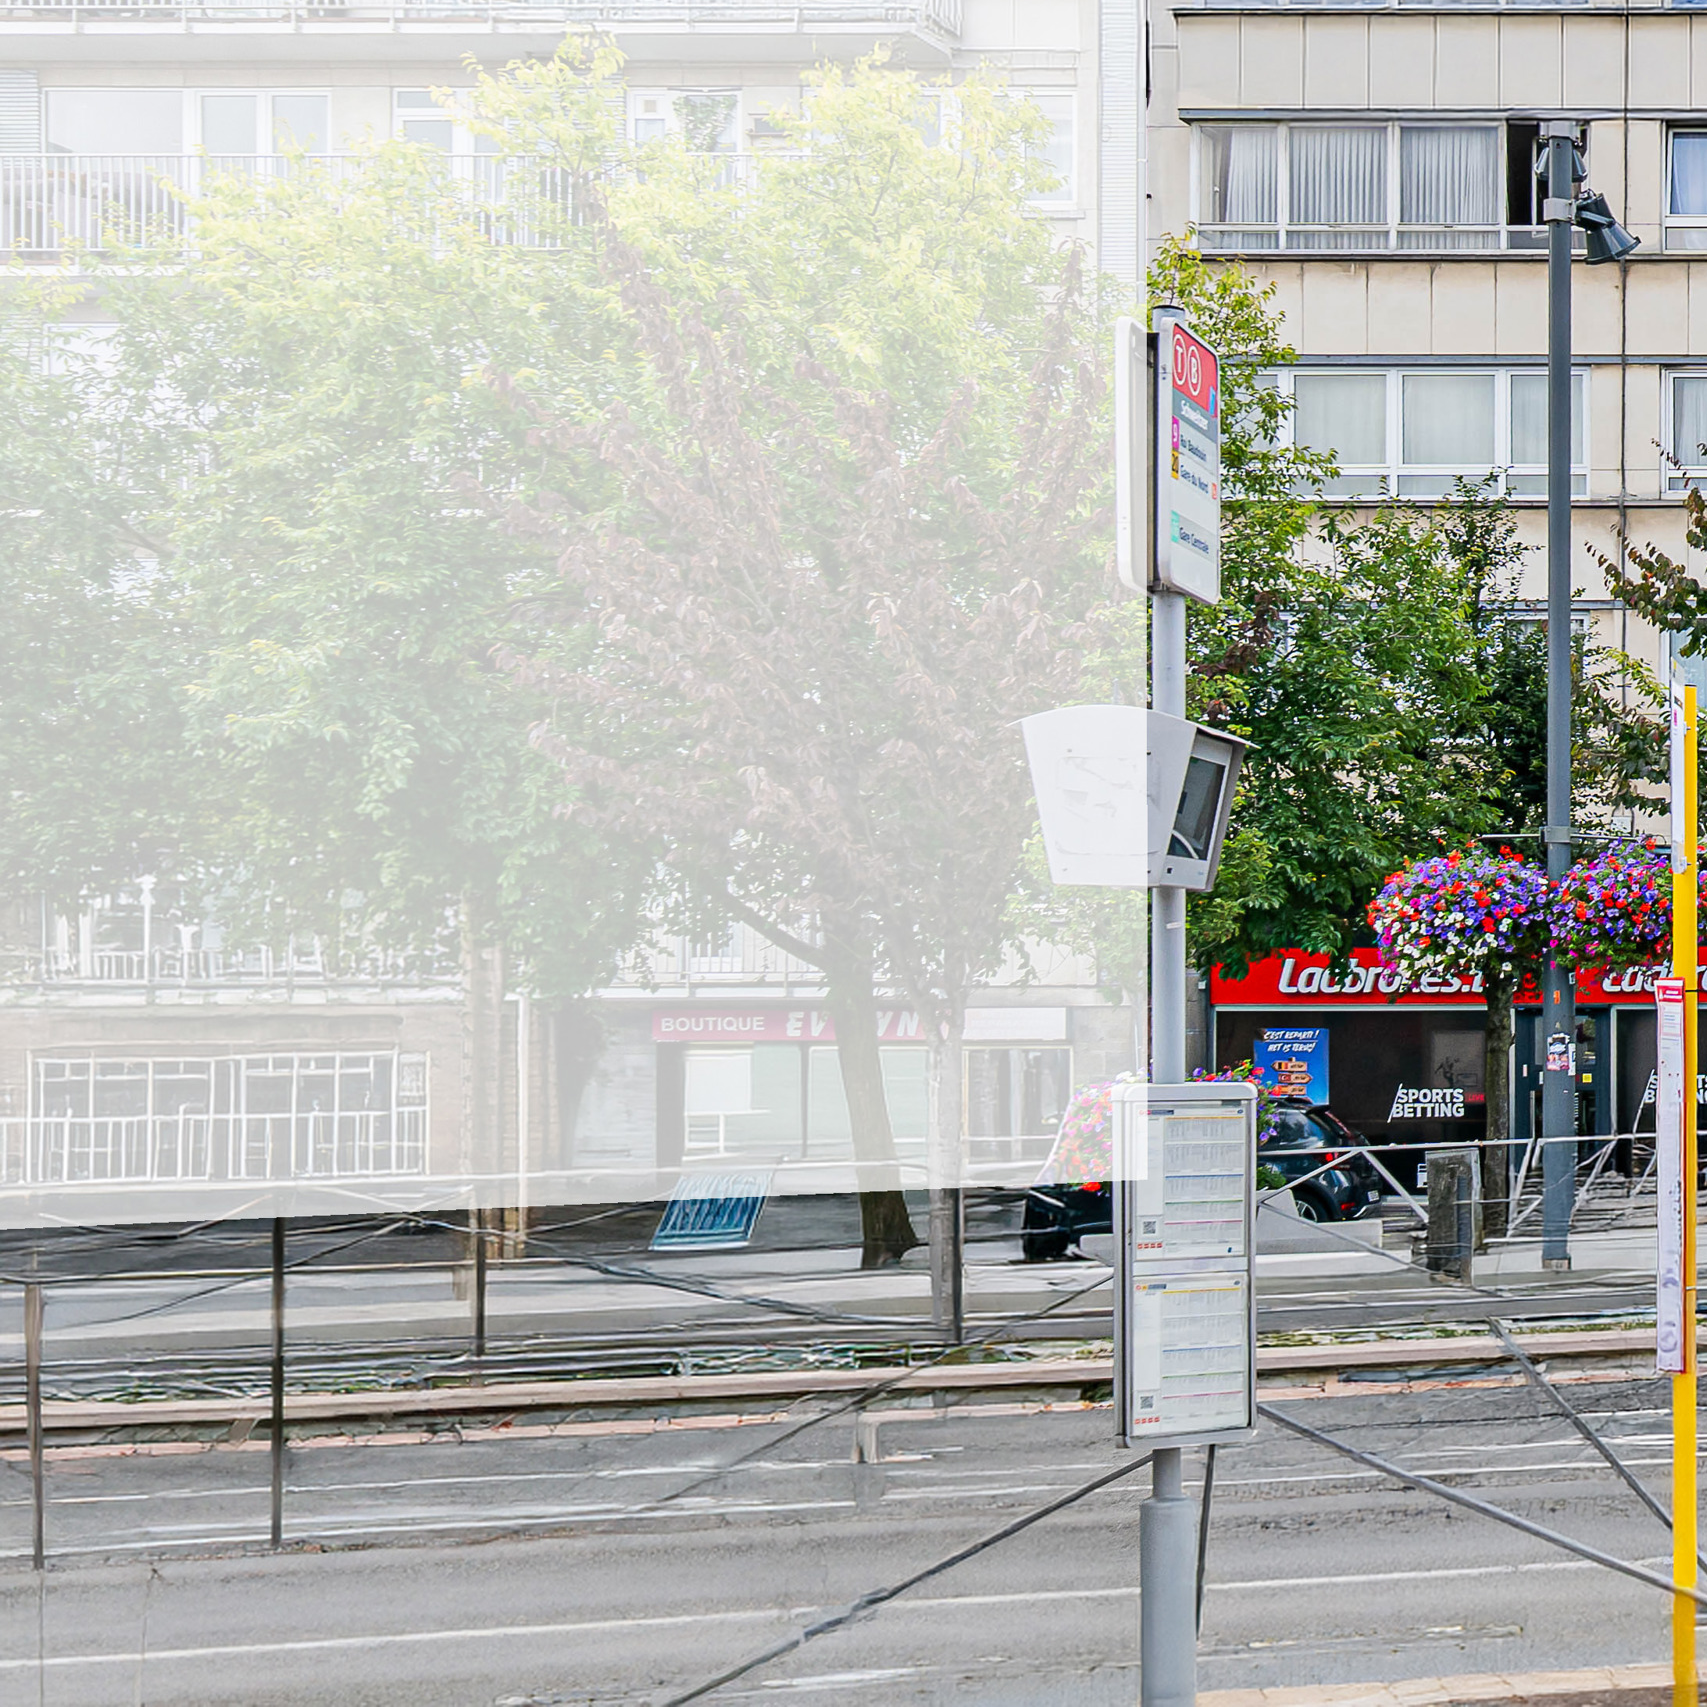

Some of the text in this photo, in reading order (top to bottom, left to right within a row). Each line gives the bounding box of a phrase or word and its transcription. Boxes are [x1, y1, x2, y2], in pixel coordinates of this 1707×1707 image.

[661, 1016, 764, 1031] BOUTIQUE
[1398, 1088, 1464, 1102] SPORTS
[1392, 1103, 1464, 1118] BETTING
